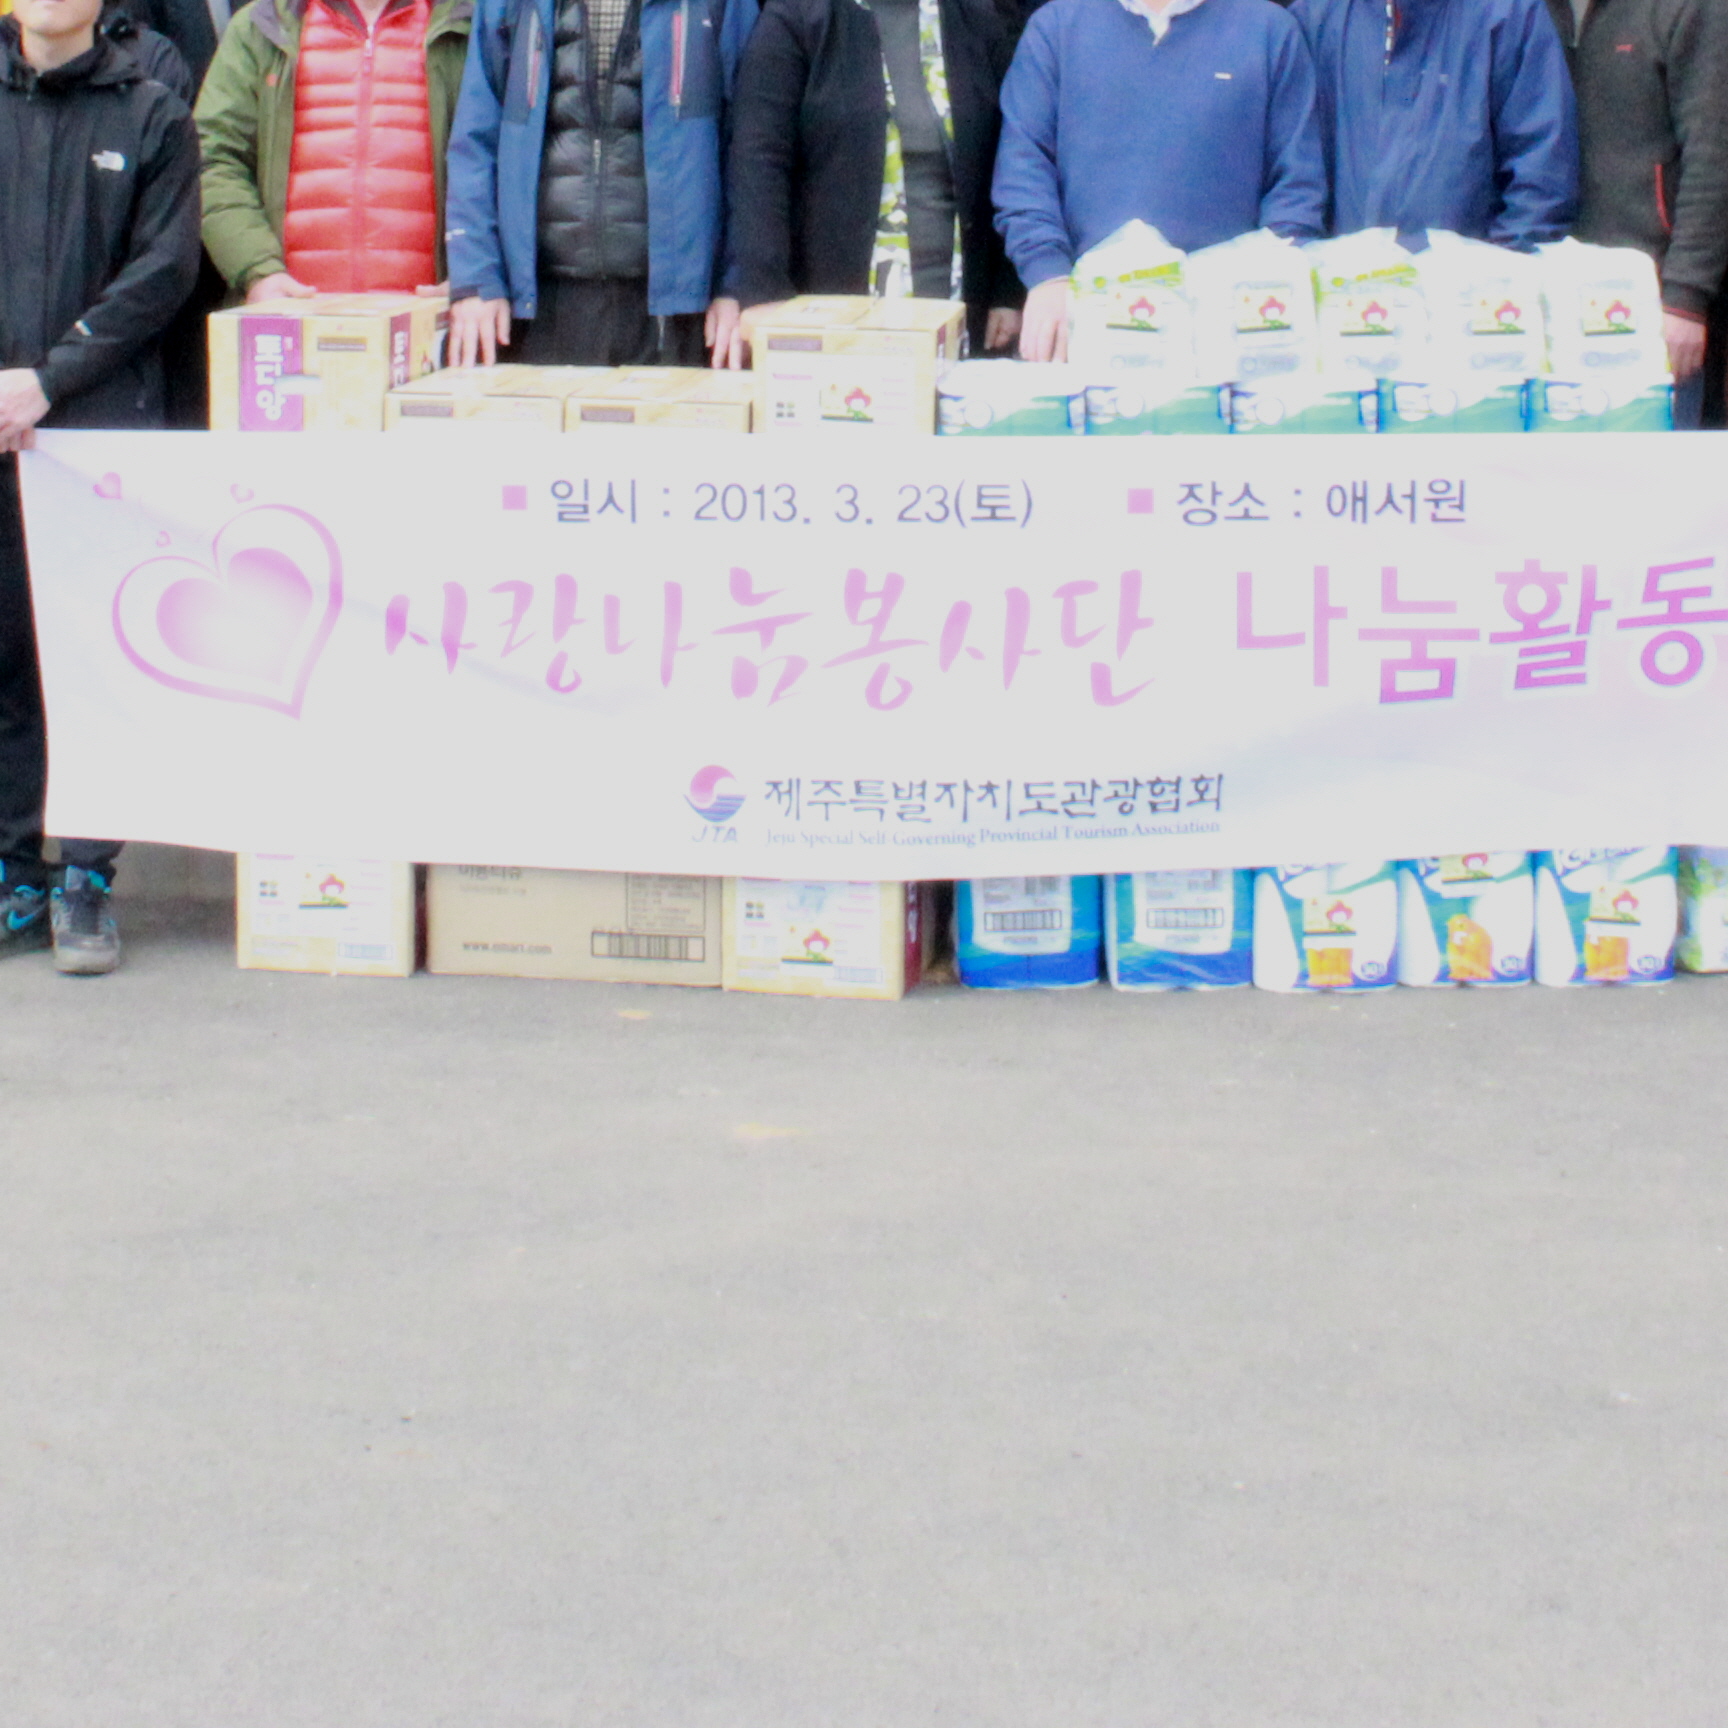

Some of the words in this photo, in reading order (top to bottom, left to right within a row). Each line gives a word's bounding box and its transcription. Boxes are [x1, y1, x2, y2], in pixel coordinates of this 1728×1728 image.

[550, 479, 638, 524] 일시
[693, 481, 812, 524] 2013.
[834, 482, 874, 525] 3.
[896, 480, 1034, 528] 23(토)
[1177, 480, 1270, 526] 장소
[1325, 478, 1467, 526] 애서원
[384, 566, 1155, 711] 사랑나눔봉사단
[764, 772, 1225, 823] 제주특별자치도관광협회
[691, 825, 738, 843] JTA
[765, 828, 795, 847] Jeju
[800, 829, 854, 848] Special
[980, 825, 1057, 843] Provincial
[1062, 824, 1128, 840] Tourism
[1132, 819, 1220, 836] Association
